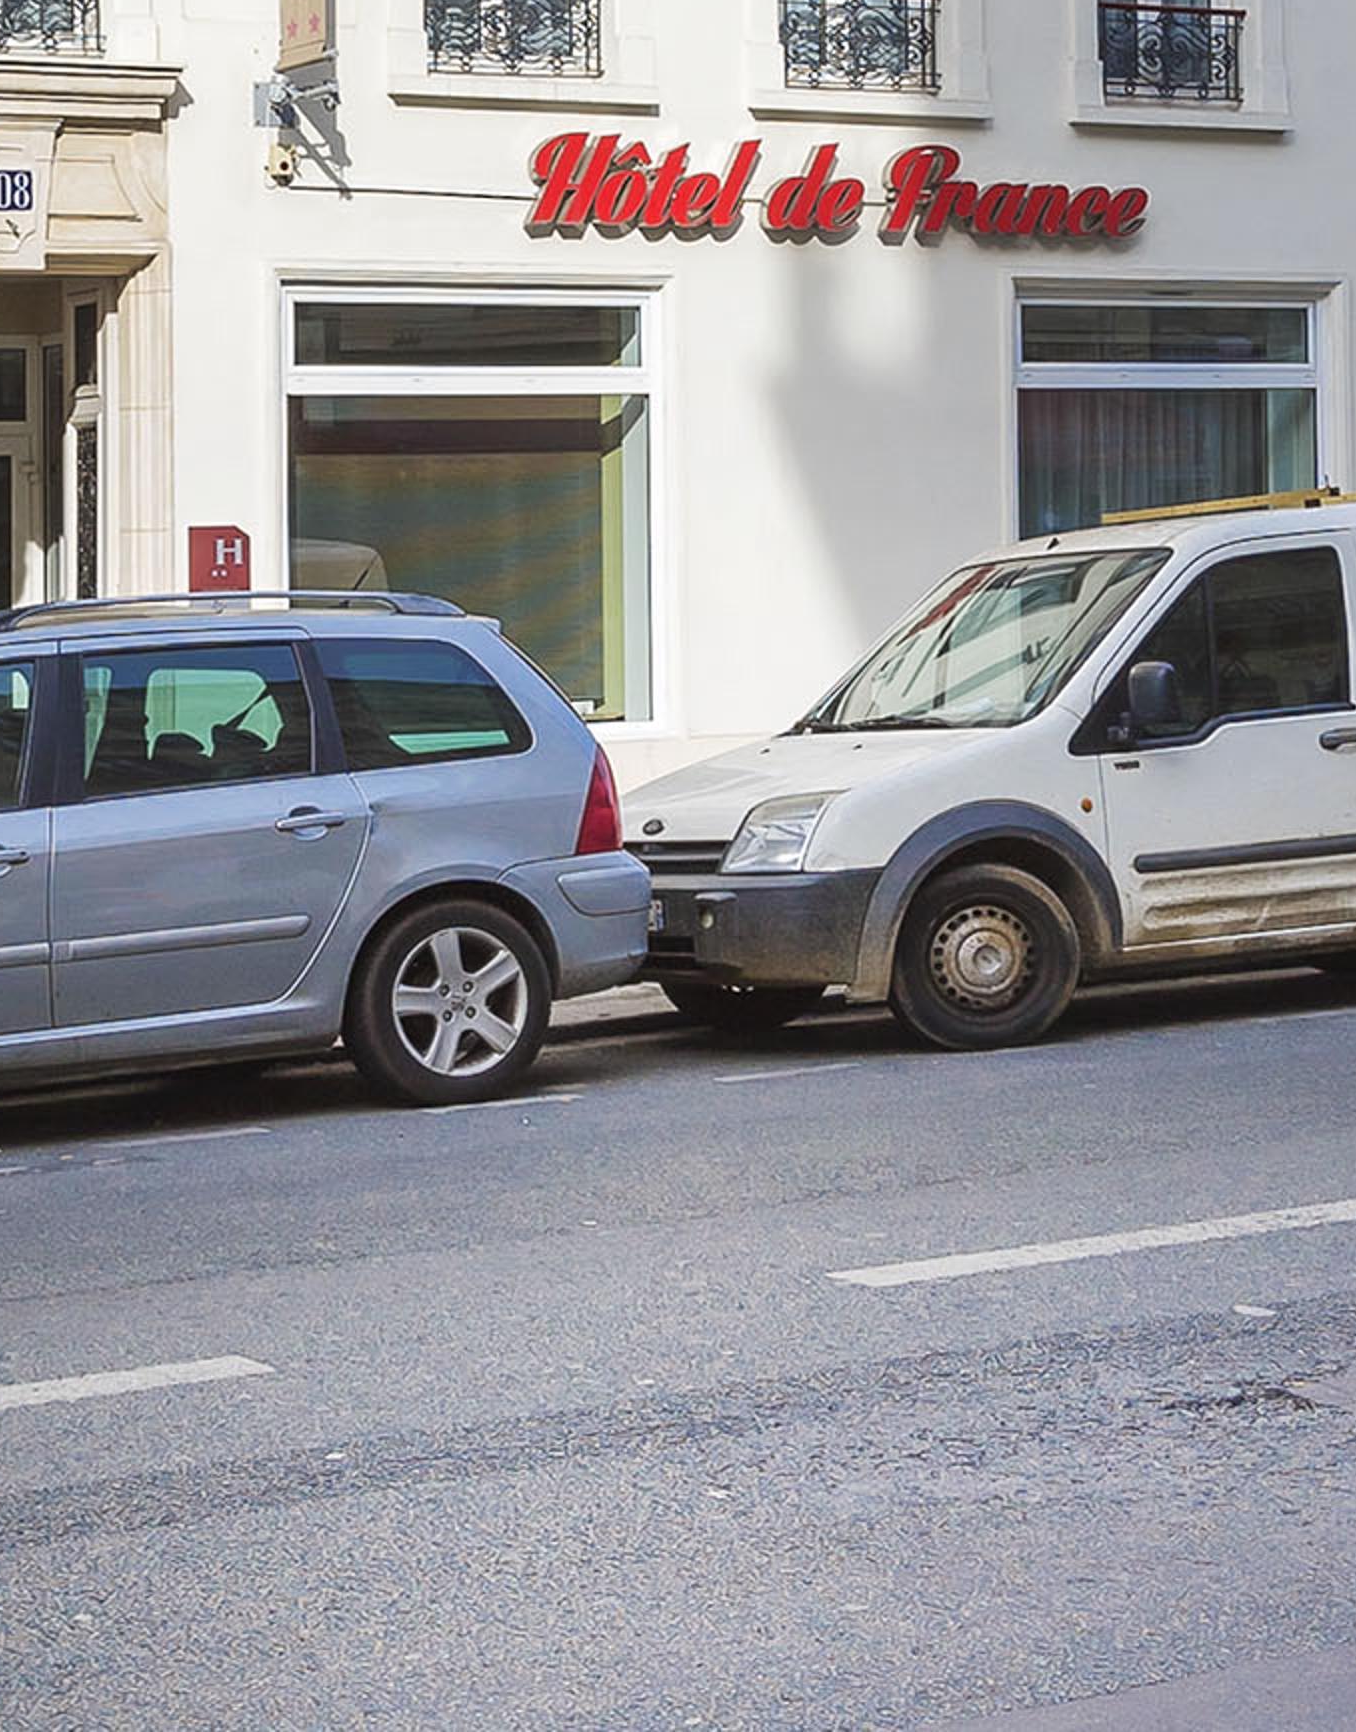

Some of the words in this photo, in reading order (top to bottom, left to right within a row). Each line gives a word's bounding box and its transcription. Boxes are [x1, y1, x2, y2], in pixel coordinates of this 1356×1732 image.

[529, 132, 764, 234] Hôtel
[764, 142, 867, 234] de
[883, 144, 1149, 240] France
[215, 538, 243, 566] H
